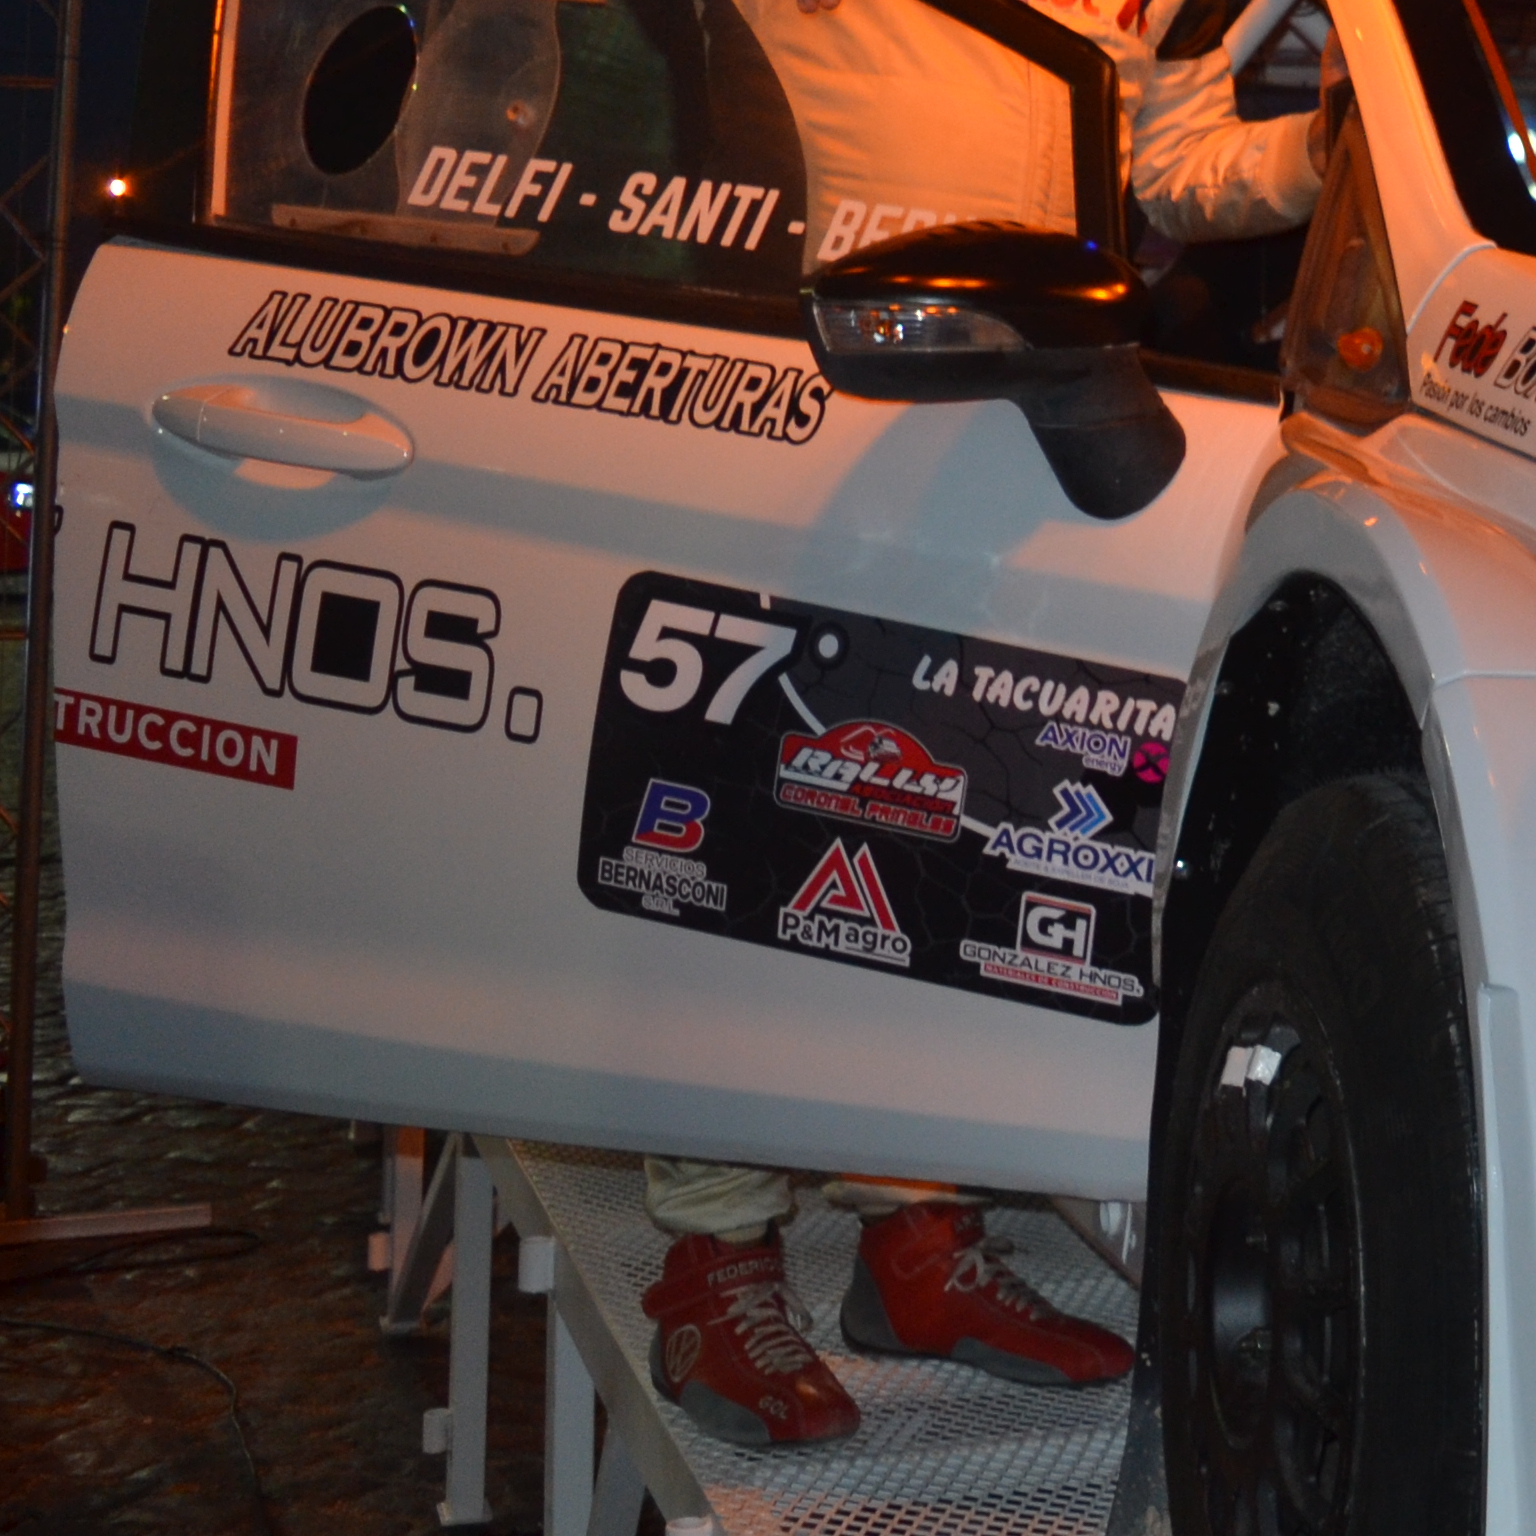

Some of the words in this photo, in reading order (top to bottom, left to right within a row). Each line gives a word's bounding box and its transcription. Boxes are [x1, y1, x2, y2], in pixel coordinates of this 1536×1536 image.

[408, 146, 575, 225] DELFI
[609, 172, 781, 251] SANTI
[817, 199, 979, 262] BE
[229, 290, 547, 397] ALUBROWN
[536, 334, 837, 448] ABERTURAS
[89, 521, 543, 744] HNOS.
[620, 599, 797, 726] 57
[912, 654, 959, 697] LA
[972, 666, 1177, 742] TACUARITA
[1040, 725, 1128, 760] AXION
[1084, 757, 1124, 775] energy
[780, 783, 862, 817] CORONEL
[864, 801, 957, 837] PRINGLES
[600, 861, 726, 909] BERNASCONI
[624, 848, 706, 878] SERVICIOS
[781, 915, 840, 949] P&M
[845, 924, 908, 954] agro
[963, 943, 1072, 979] GONZALEZ
[1079, 969, 1141, 994] HNOS.
